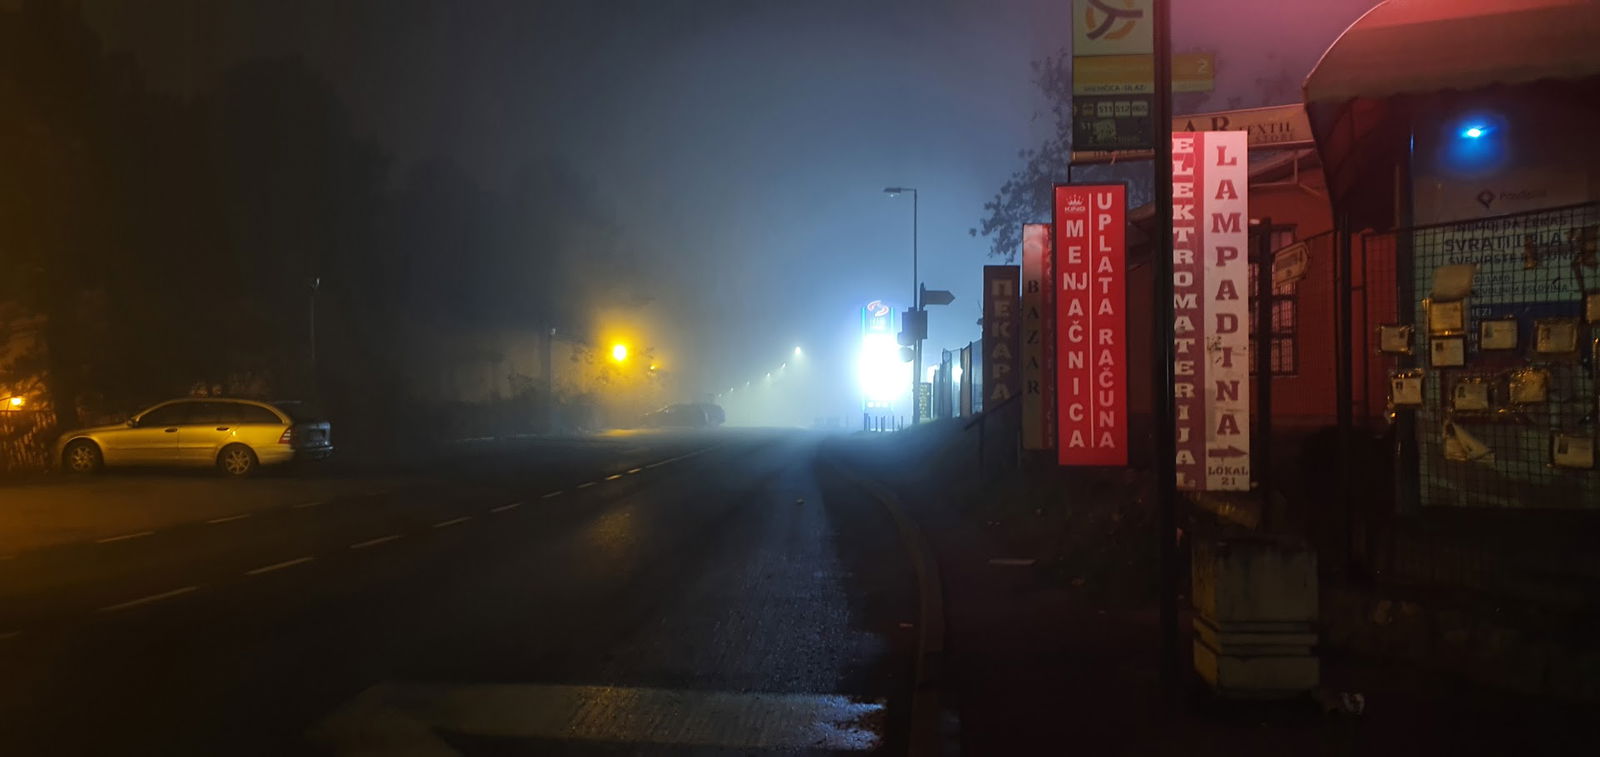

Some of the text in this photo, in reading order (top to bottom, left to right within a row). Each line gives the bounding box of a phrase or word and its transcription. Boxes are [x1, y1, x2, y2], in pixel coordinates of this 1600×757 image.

[1197, 58, 1209, 73] 2
[991, 279, 1013, 401] ПЕКАРА
[1027, 280, 1040, 394] BAZAR
[1063, 218, 1088, 449] MENJAČNICA
[1097, 192, 1116, 449] UPLATA RAČUNA
[1172, 137, 1197, 487] ELEKTROMATERIJAL
[1211, 145, 1241, 436] LAMPADINA
[1208, 466, 1248, 476] LOKAL
[1221, 477, 1236, 485] 21
